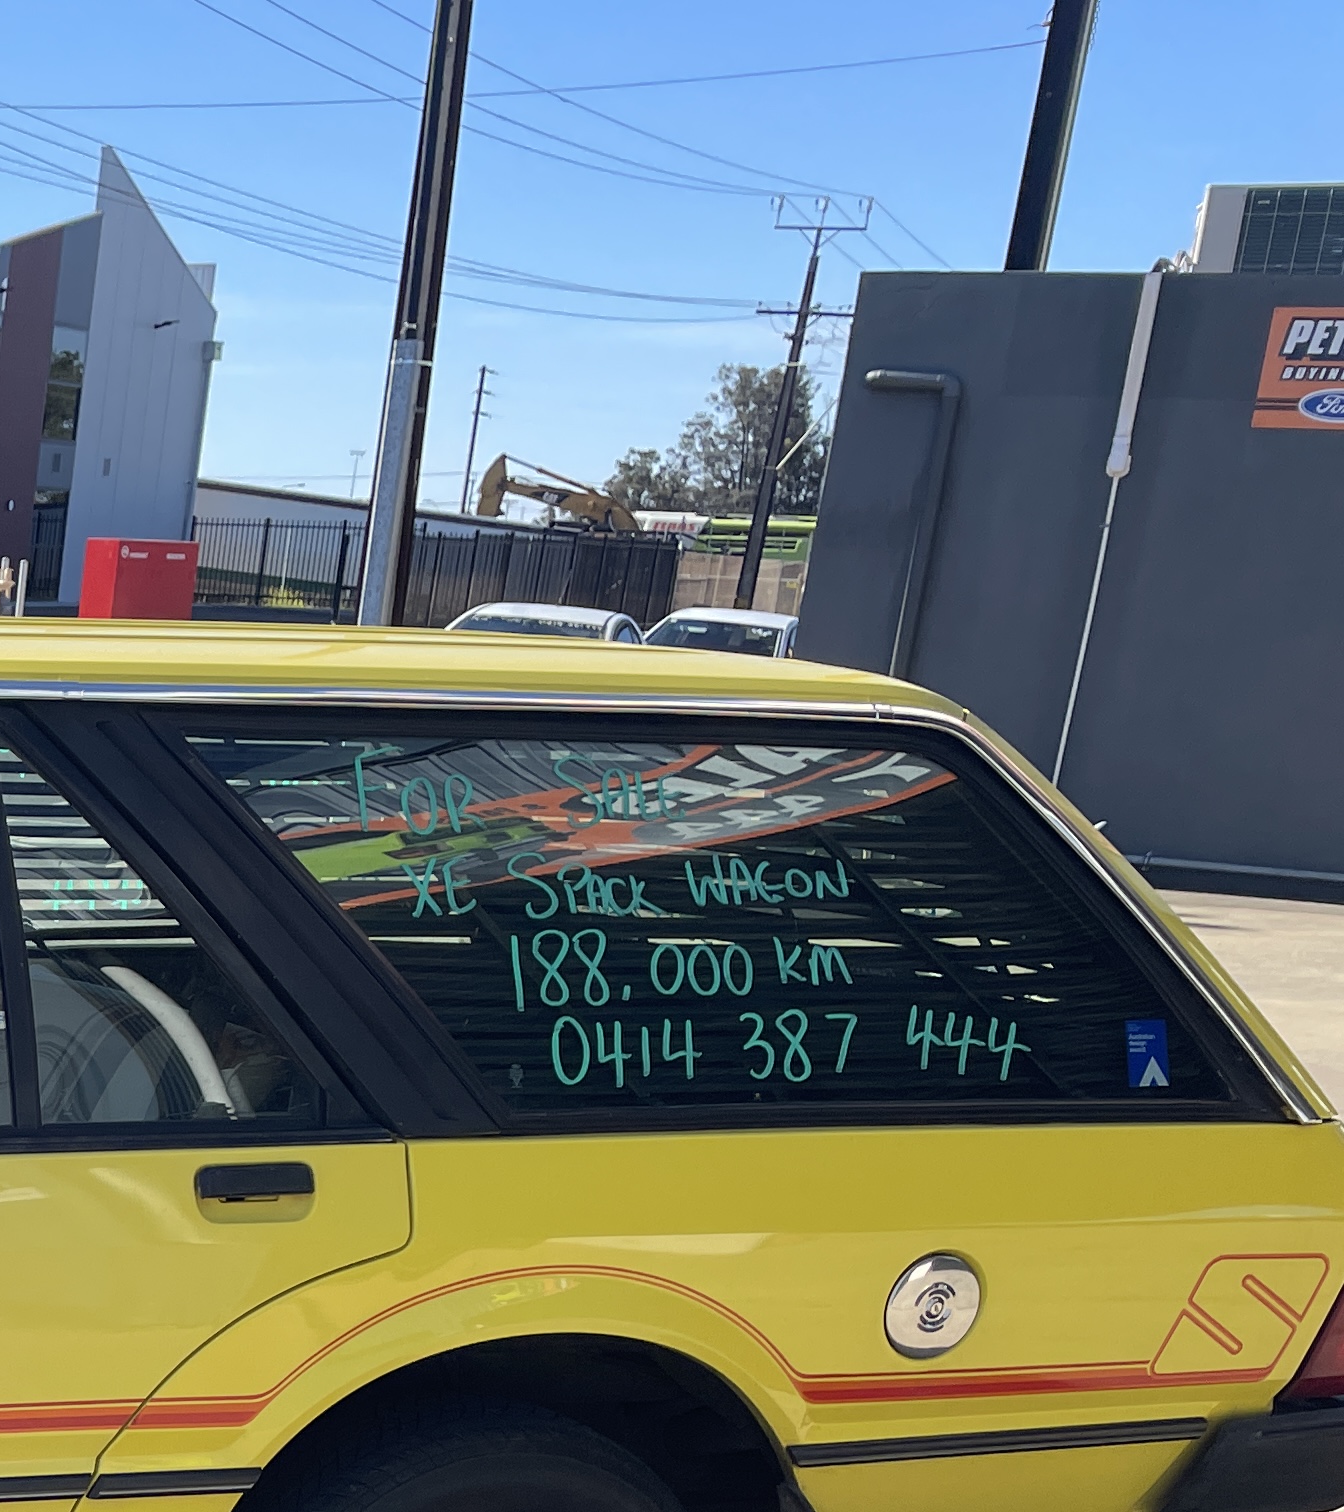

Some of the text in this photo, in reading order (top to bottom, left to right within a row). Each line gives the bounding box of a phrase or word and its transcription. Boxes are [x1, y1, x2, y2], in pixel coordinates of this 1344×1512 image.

[1281, 366, 1344, 379] BUYIN
[353, 745, 687, 835] FOR SALE
[401, 857, 476, 918] XE
[685, 854, 854, 907] WAGON
[551, 1004, 1031, 1088] 0414 387 444
